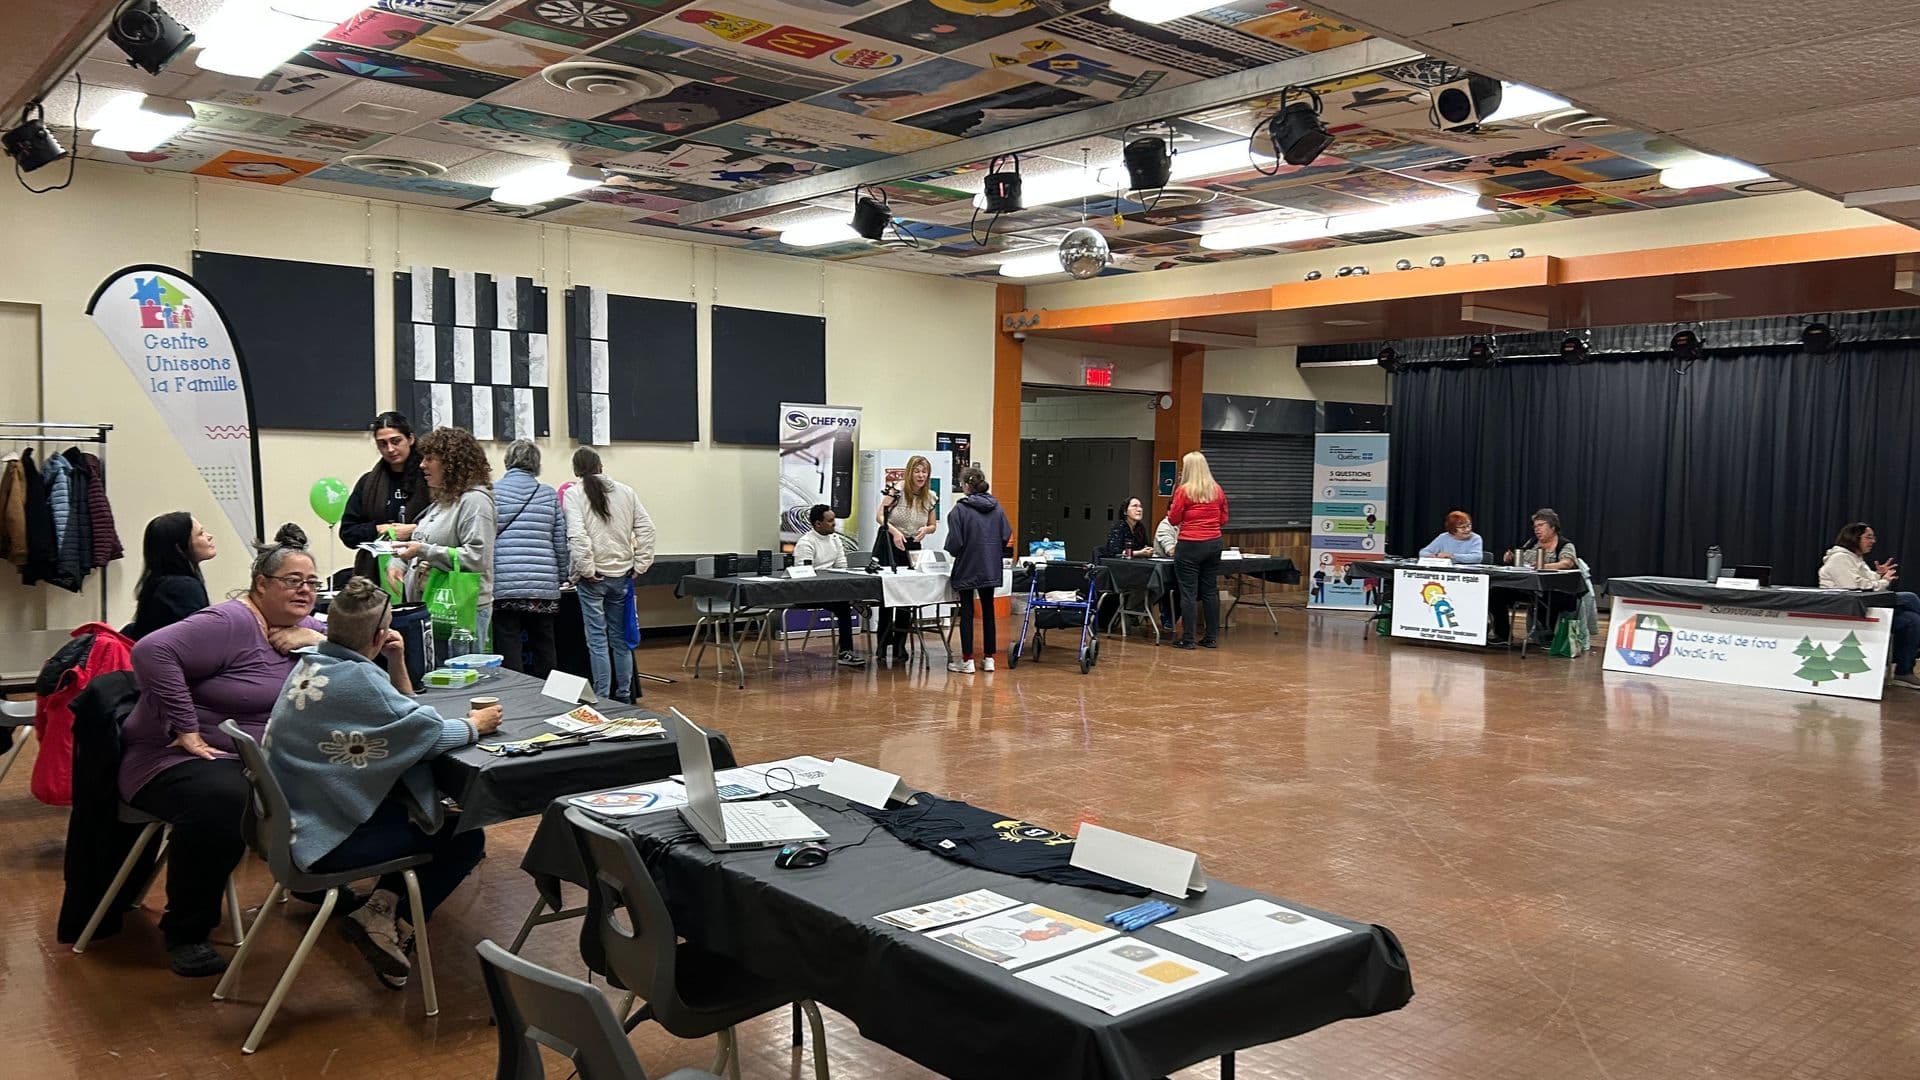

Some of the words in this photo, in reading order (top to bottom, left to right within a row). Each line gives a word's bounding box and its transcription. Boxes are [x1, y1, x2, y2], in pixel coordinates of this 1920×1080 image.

[854, 50, 887, 69] KING
[144, 333, 209, 350] Centre
[146, 356, 231, 372] Unissons
[150, 378, 169, 394] la
[175, 376, 237, 393] Famille
[811, 416, 837, 426] CHEF
[837, 417, 857, 428] 99,9
[1676, 630, 1699, 642] Club
[1701, 632, 1714, 645] de
[1716, 634, 1731, 646] ski
[1734, 635, 1749, 647] de
[1751, 636, 1778, 650] fond
[1674, 646, 1706, 659] Nordic
